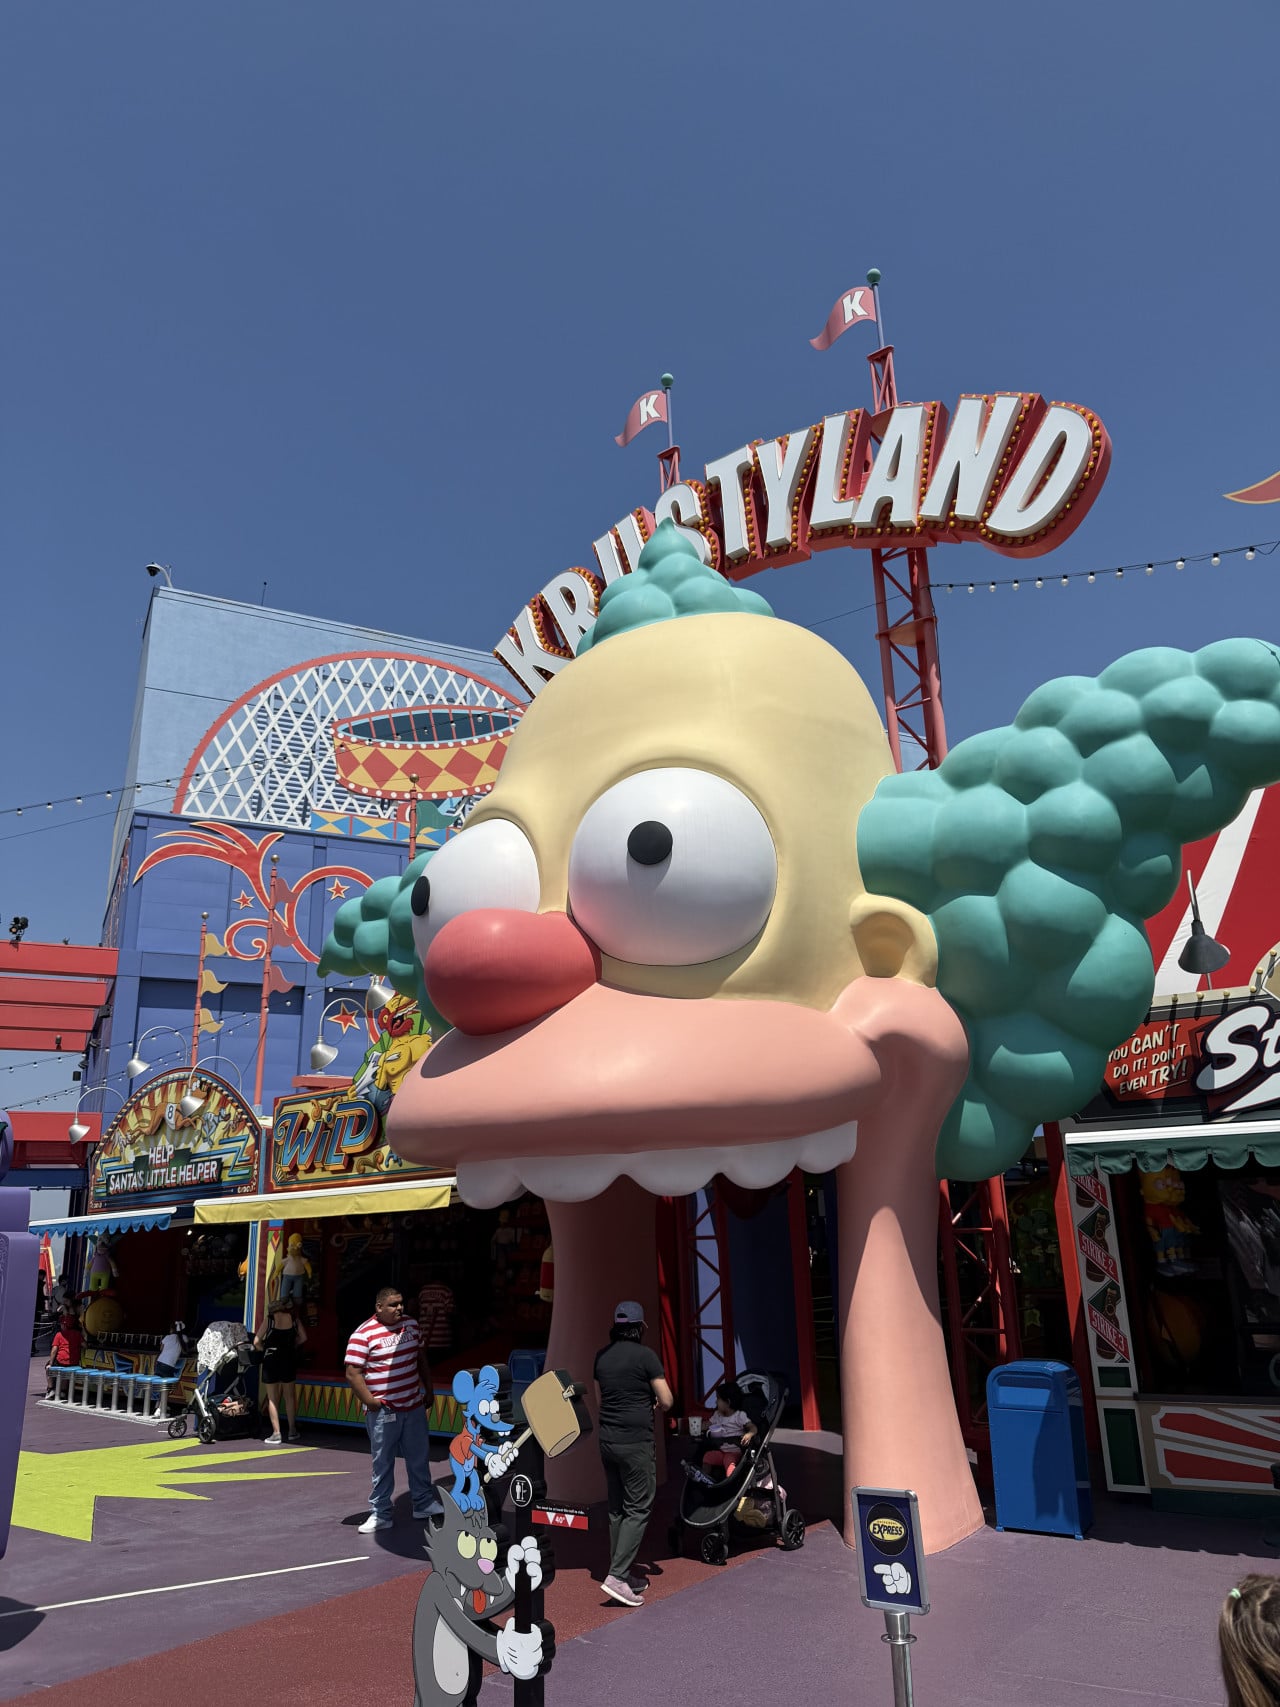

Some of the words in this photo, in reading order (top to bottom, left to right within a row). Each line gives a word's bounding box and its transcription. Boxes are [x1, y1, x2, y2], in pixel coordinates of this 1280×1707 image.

[842, 290, 868, 324] K
[639, 394, 661, 426] K
[1108, 1046, 1129, 1063] YOU
[1131, 1023, 1181, 1055] CAN'T
[1113, 1063, 1129, 1079] DO
[1133, 1057, 1148, 1072] IT!
[1151, 1043, 1187, 1066] DON'T
[1120, 1075, 1148, 1094] EVEN
[1149, 1059, 1187, 1087] TRY!
[167, 1105, 174, 1119] 8
[148, 1144, 175, 1166] HELP
[109, 1168, 145, 1193] SANTA'S
[145, 1166, 177, 1188] LITTLE
[178, 1160, 218, 1184] HELPER
[1082, 1236, 1107, 1268] STRIKE
[1108, 1259, 1114, 1275] 2
[1092, 1310, 1117, 1346] STRIKE
[1118, 1334, 1125, 1352] 3
[872, 1522, 903, 1539] EXPRESS
